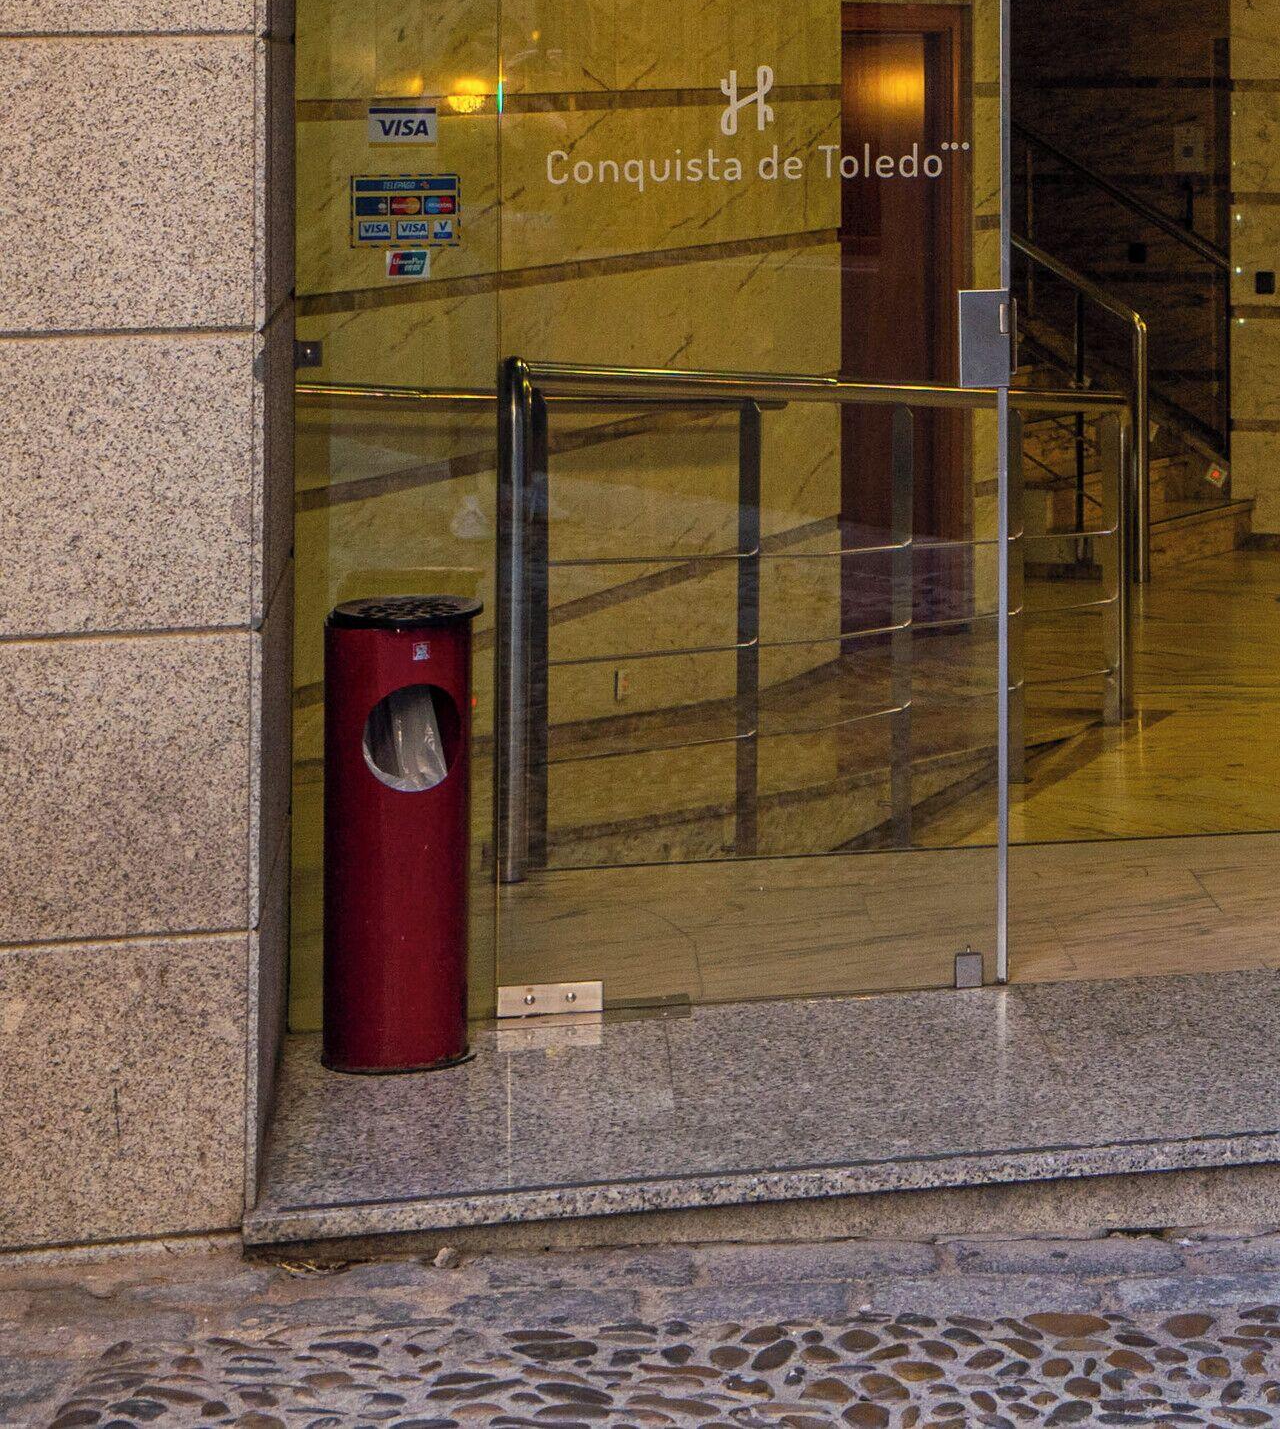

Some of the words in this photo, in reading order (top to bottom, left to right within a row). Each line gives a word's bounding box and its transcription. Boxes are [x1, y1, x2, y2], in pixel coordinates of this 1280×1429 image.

[375, 119, 429, 136] VISA
[546, 149, 742, 192] Conquista
[758, 144, 803, 180] de
[818, 142, 943, 178] Toledo
[363, 223, 389, 233] VISA
[401, 223, 427, 233] VISA
